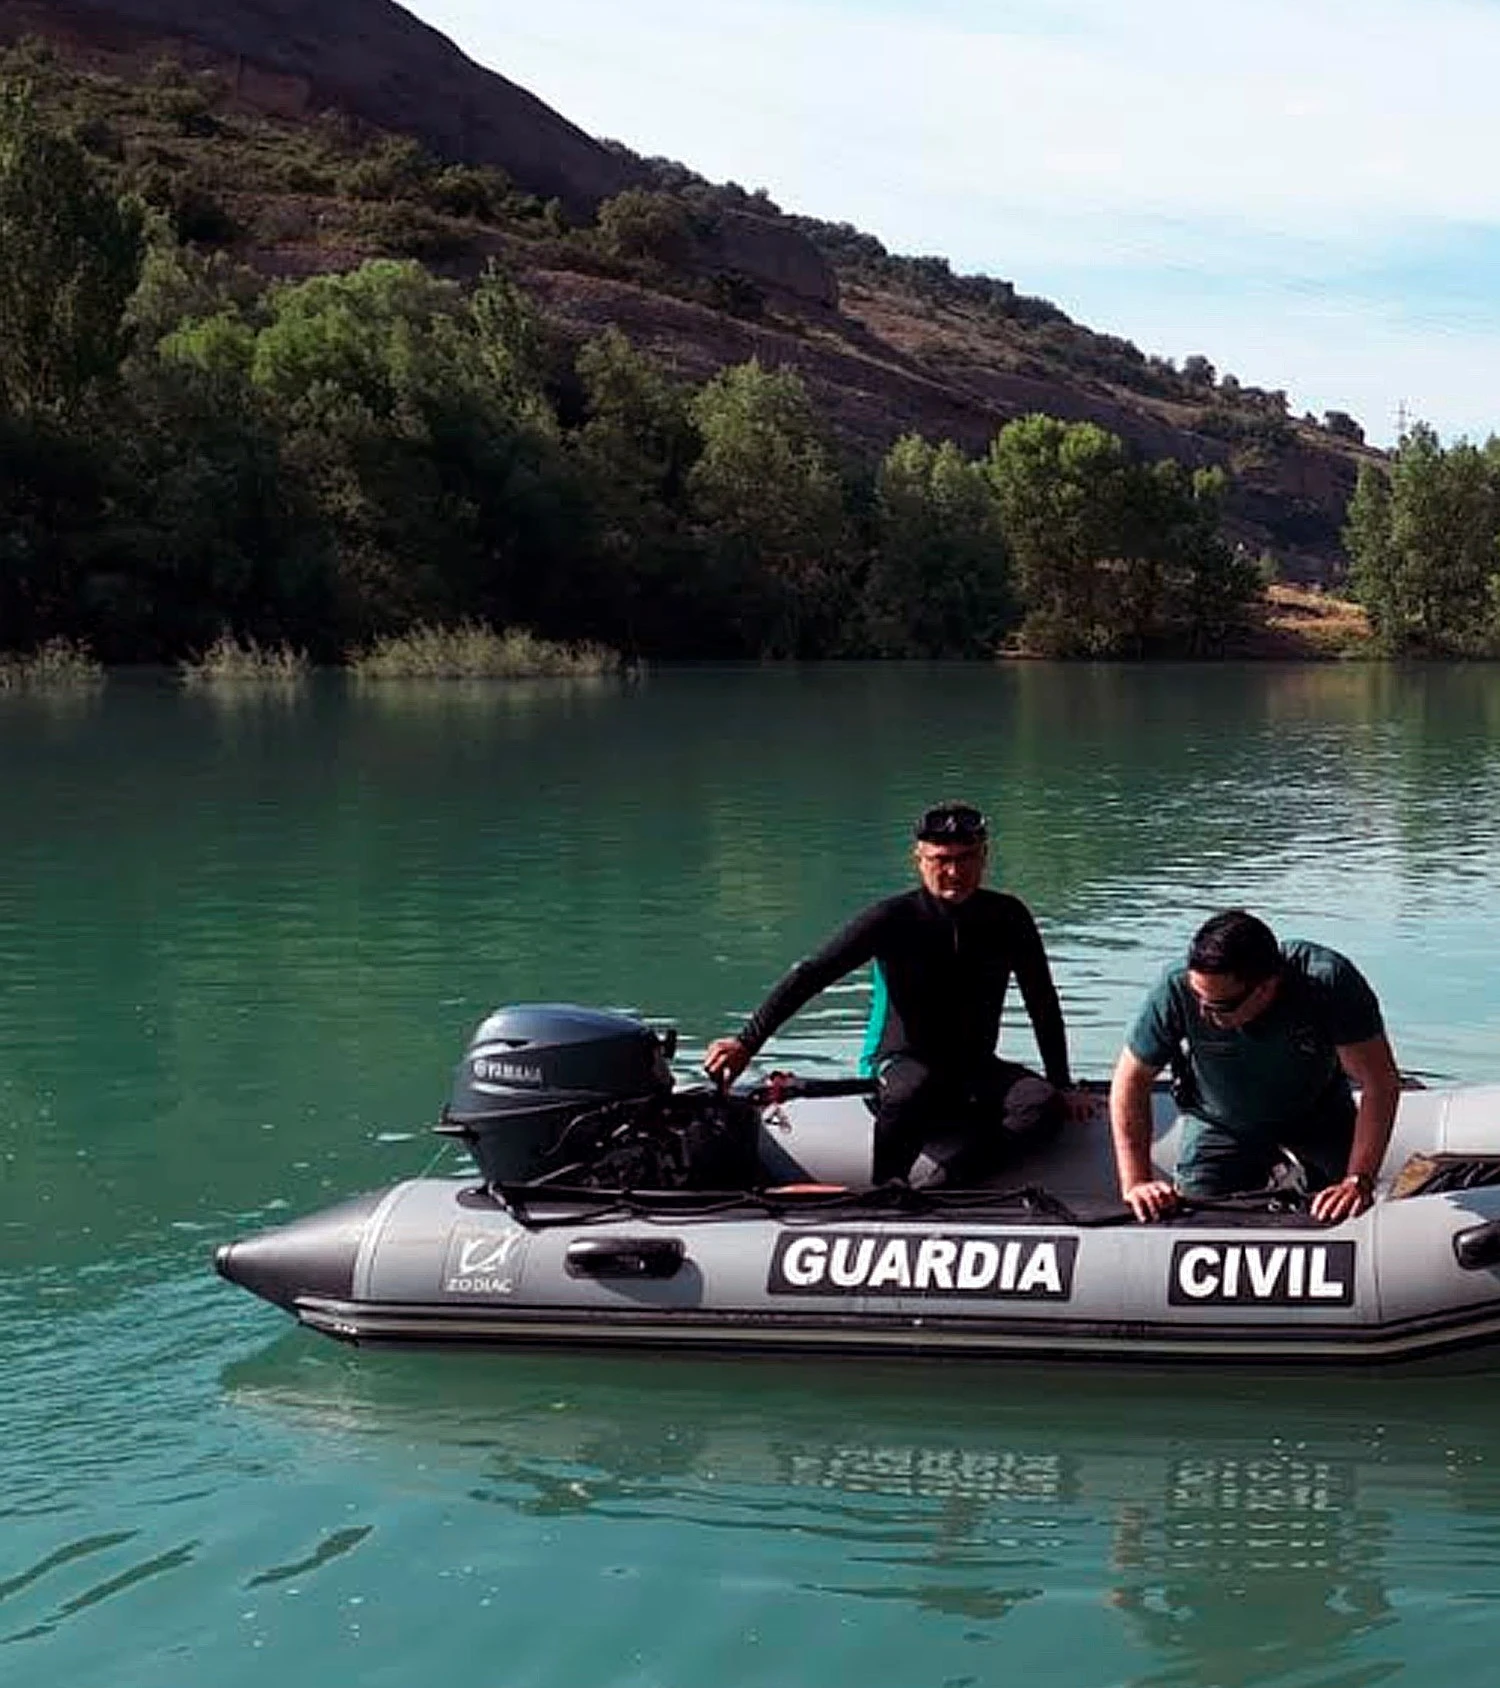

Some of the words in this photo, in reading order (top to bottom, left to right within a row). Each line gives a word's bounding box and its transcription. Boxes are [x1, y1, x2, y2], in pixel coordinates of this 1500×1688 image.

[488, 1061, 542, 1082] YAMAHA
[783, 1236, 1062, 1292] GUARDIA
[1179, 1246, 1343, 1297] CIVIL
[446, 1278, 513, 1293] ZODIAC
